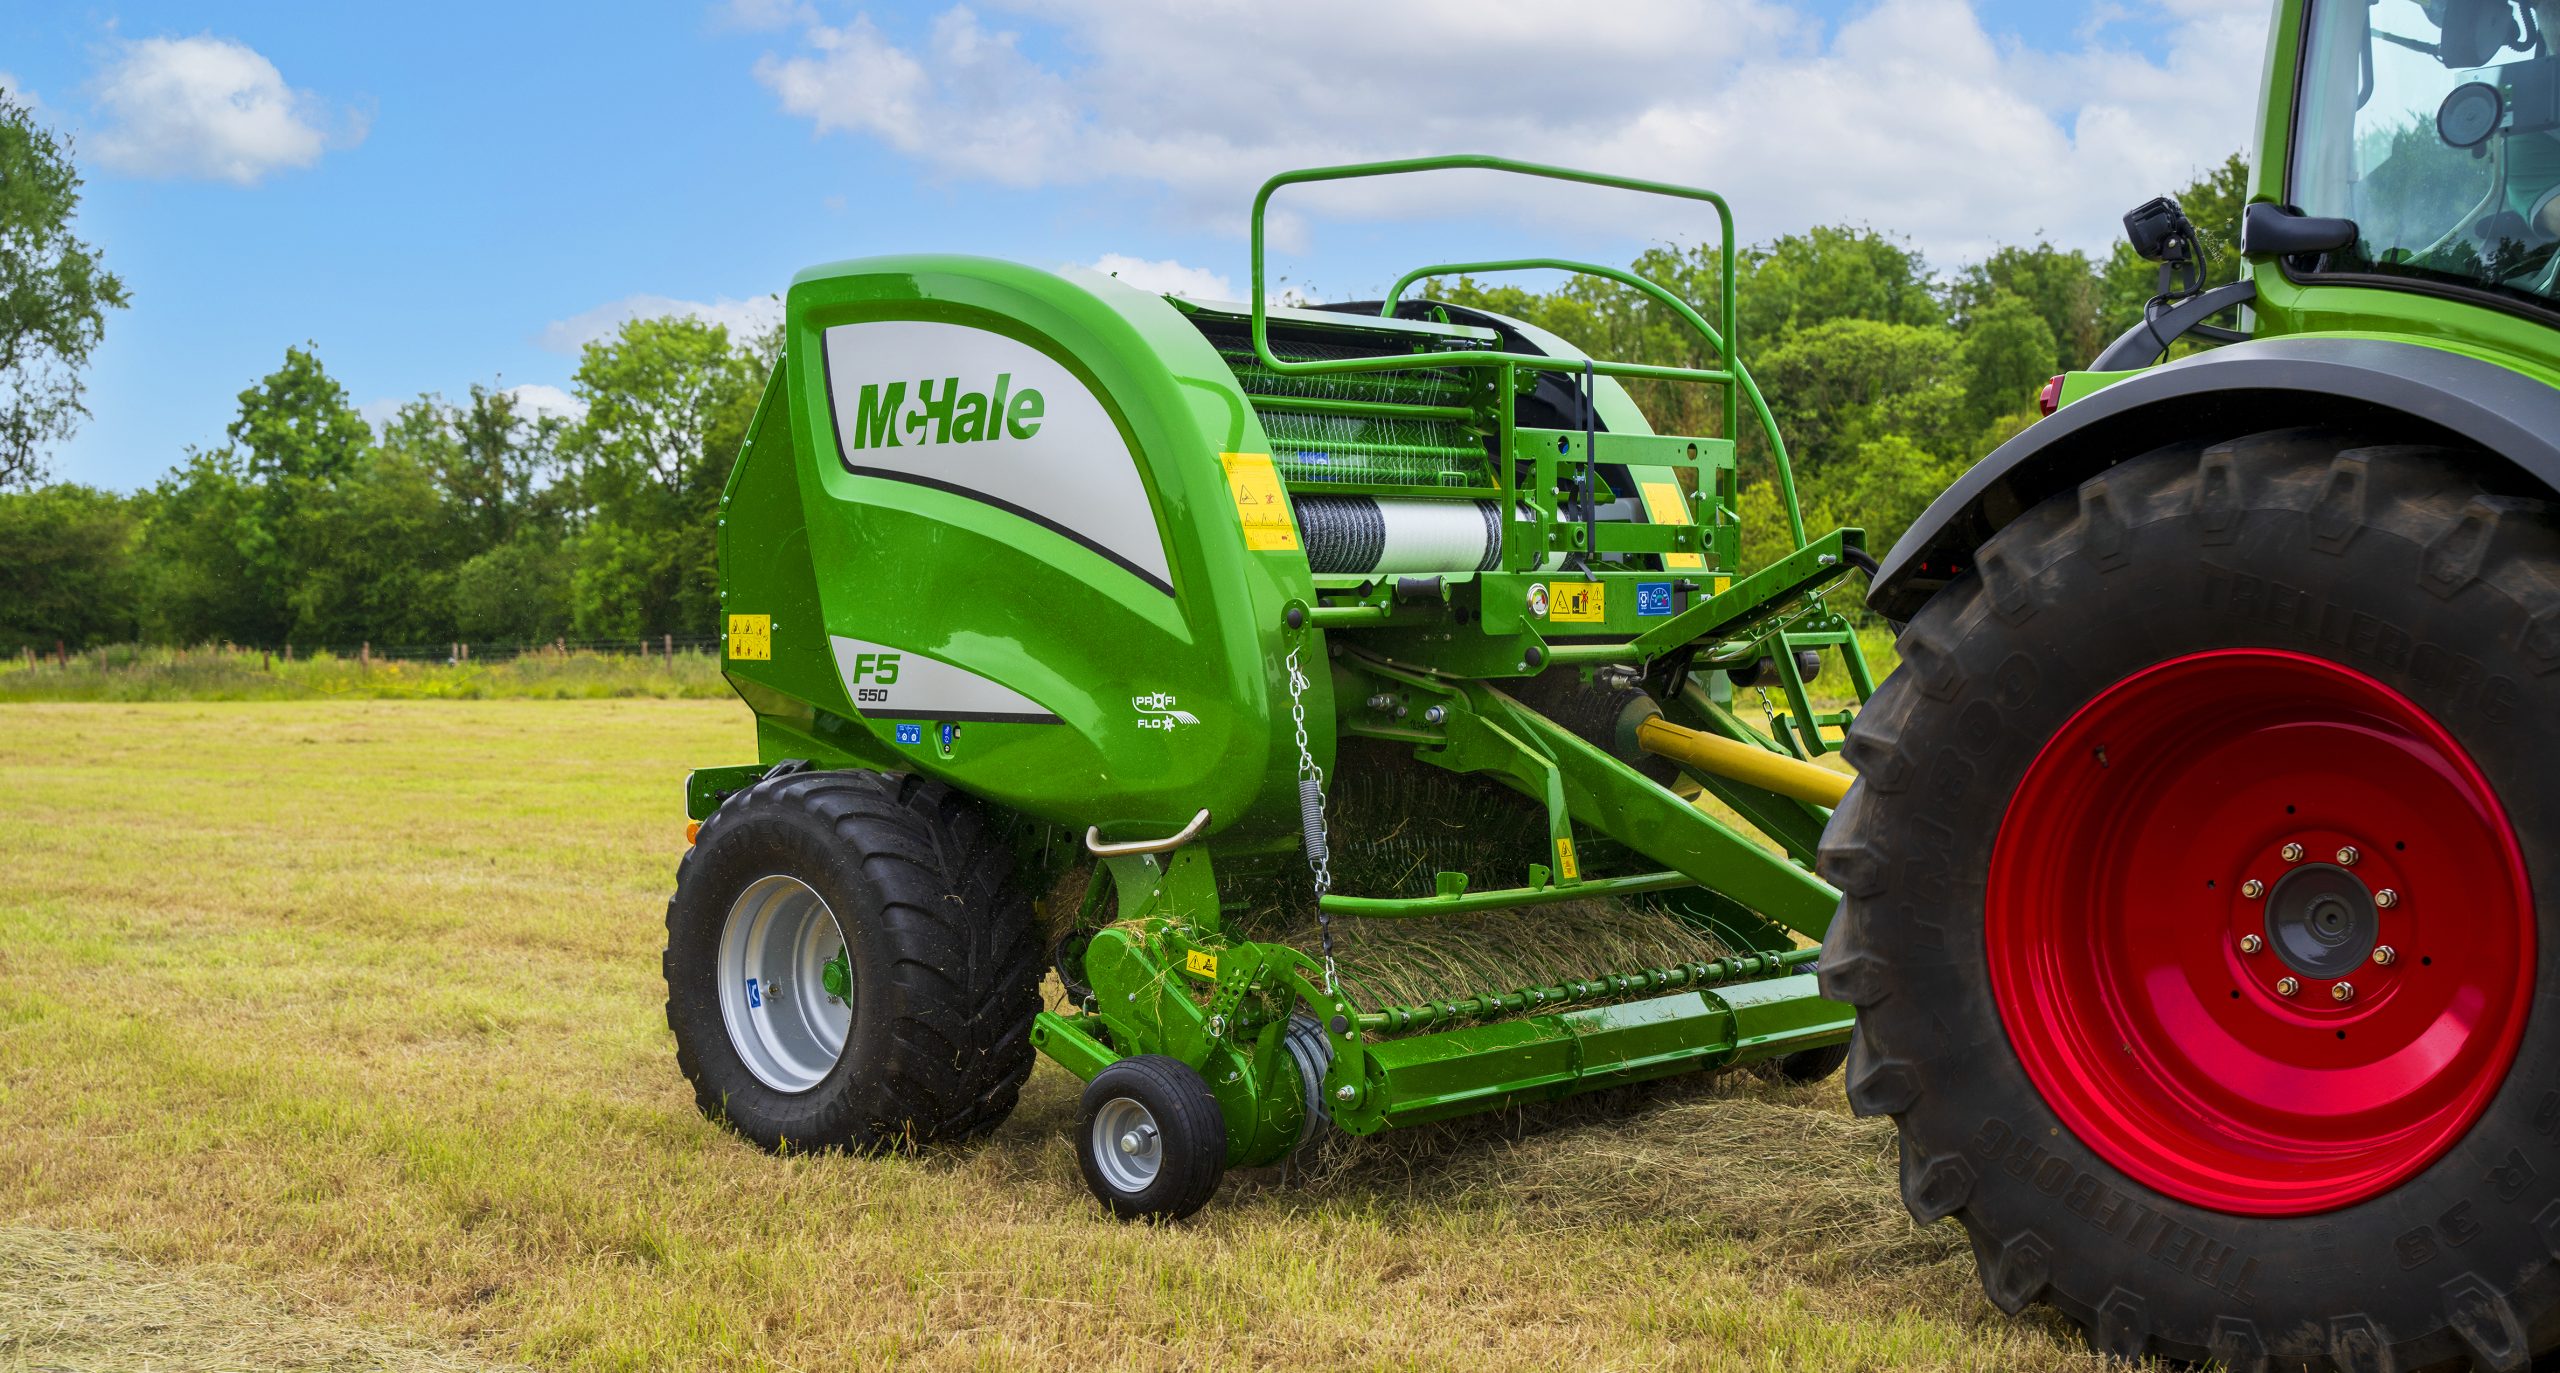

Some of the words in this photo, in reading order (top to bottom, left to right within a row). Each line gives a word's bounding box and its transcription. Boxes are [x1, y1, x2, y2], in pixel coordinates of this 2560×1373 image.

[853, 373, 1045, 450] McHale
[2199, 558, 2520, 724] TRELLEBORG
[853, 654, 901, 684] F5
[858, 689, 888, 701] 550
[1136, 694, 1176, 708] PROFI
[1971, 1117, 2260, 1307] TRELLEBORG
